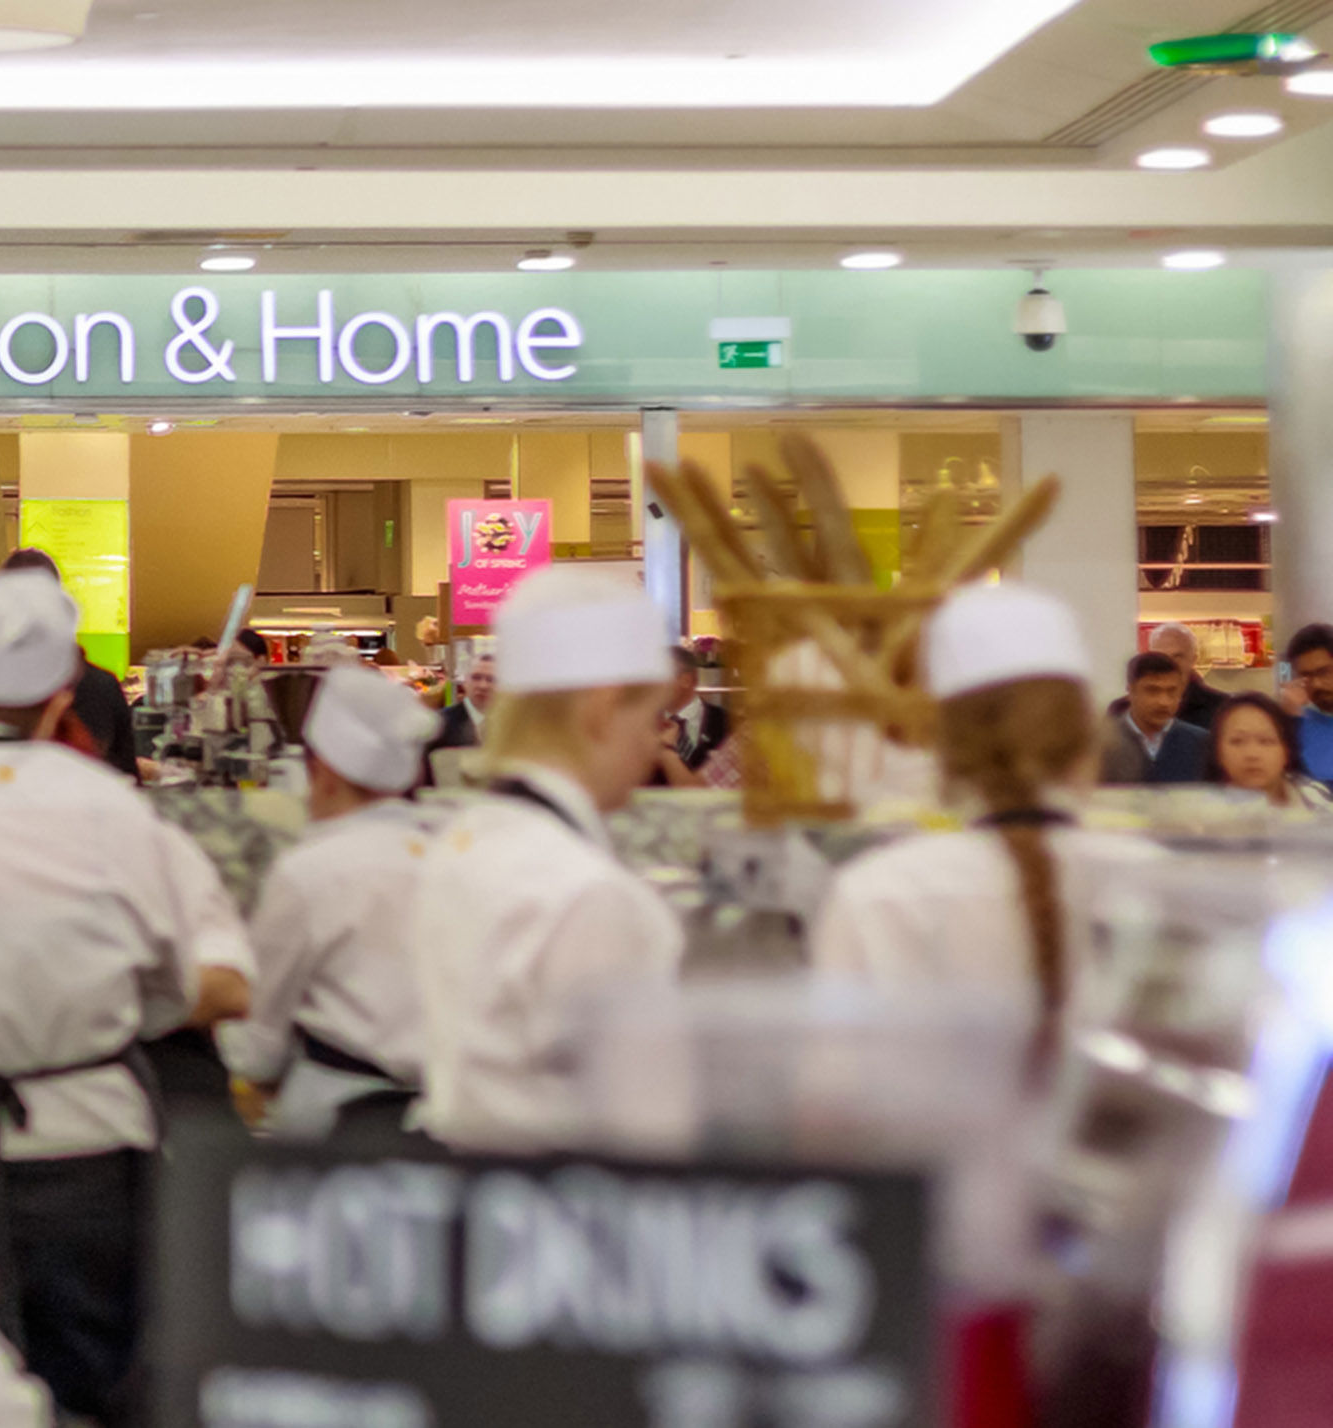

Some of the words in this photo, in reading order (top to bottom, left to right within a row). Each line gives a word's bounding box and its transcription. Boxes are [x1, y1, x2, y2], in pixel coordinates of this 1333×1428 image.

[164, 286, 237, 384] &
[260, 288, 583, 385] Home
[457, 510, 543, 568] JOY
